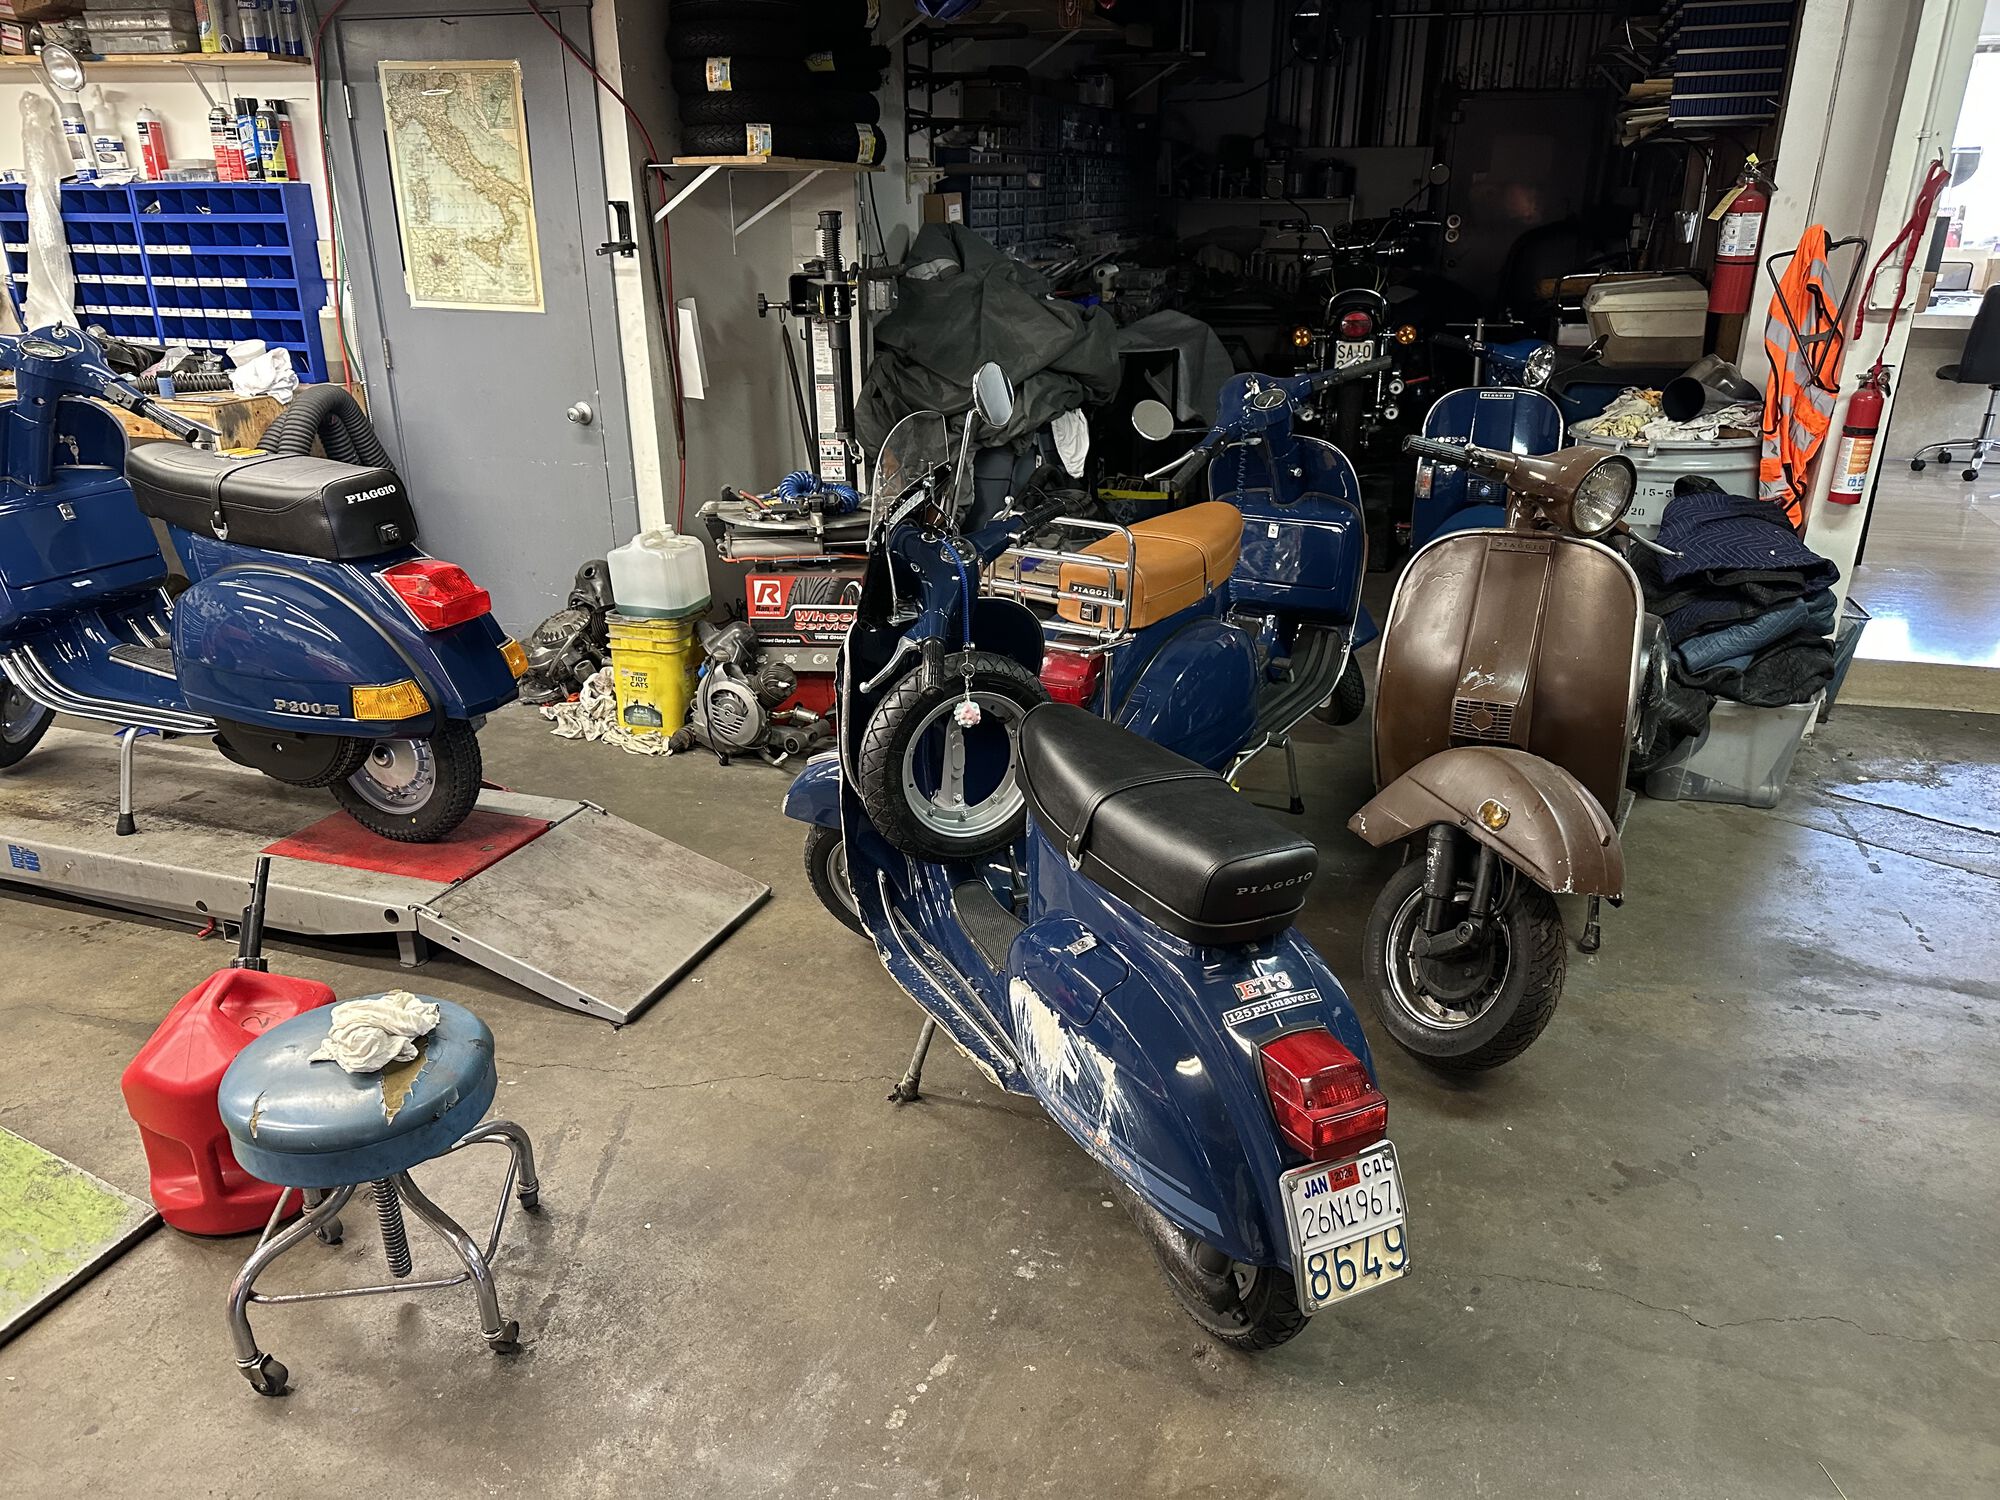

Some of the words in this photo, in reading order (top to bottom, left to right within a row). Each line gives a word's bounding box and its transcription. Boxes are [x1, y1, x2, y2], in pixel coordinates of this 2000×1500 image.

[345, 484, 396, 504] PIAGGIO
[757, 583, 779, 603] R
[793, 622, 850, 631] Servic
[1236, 871, 1313, 896] PIAGGIO
[1235, 970, 1293, 1001] ET3
[1304, 1175, 1329, 1200] JAN
[1333, 1168, 1354, 1181] 2026
[1302, 1180, 1392, 1239] 26N1967
[1307, 1224, 1408, 1300] 8649
